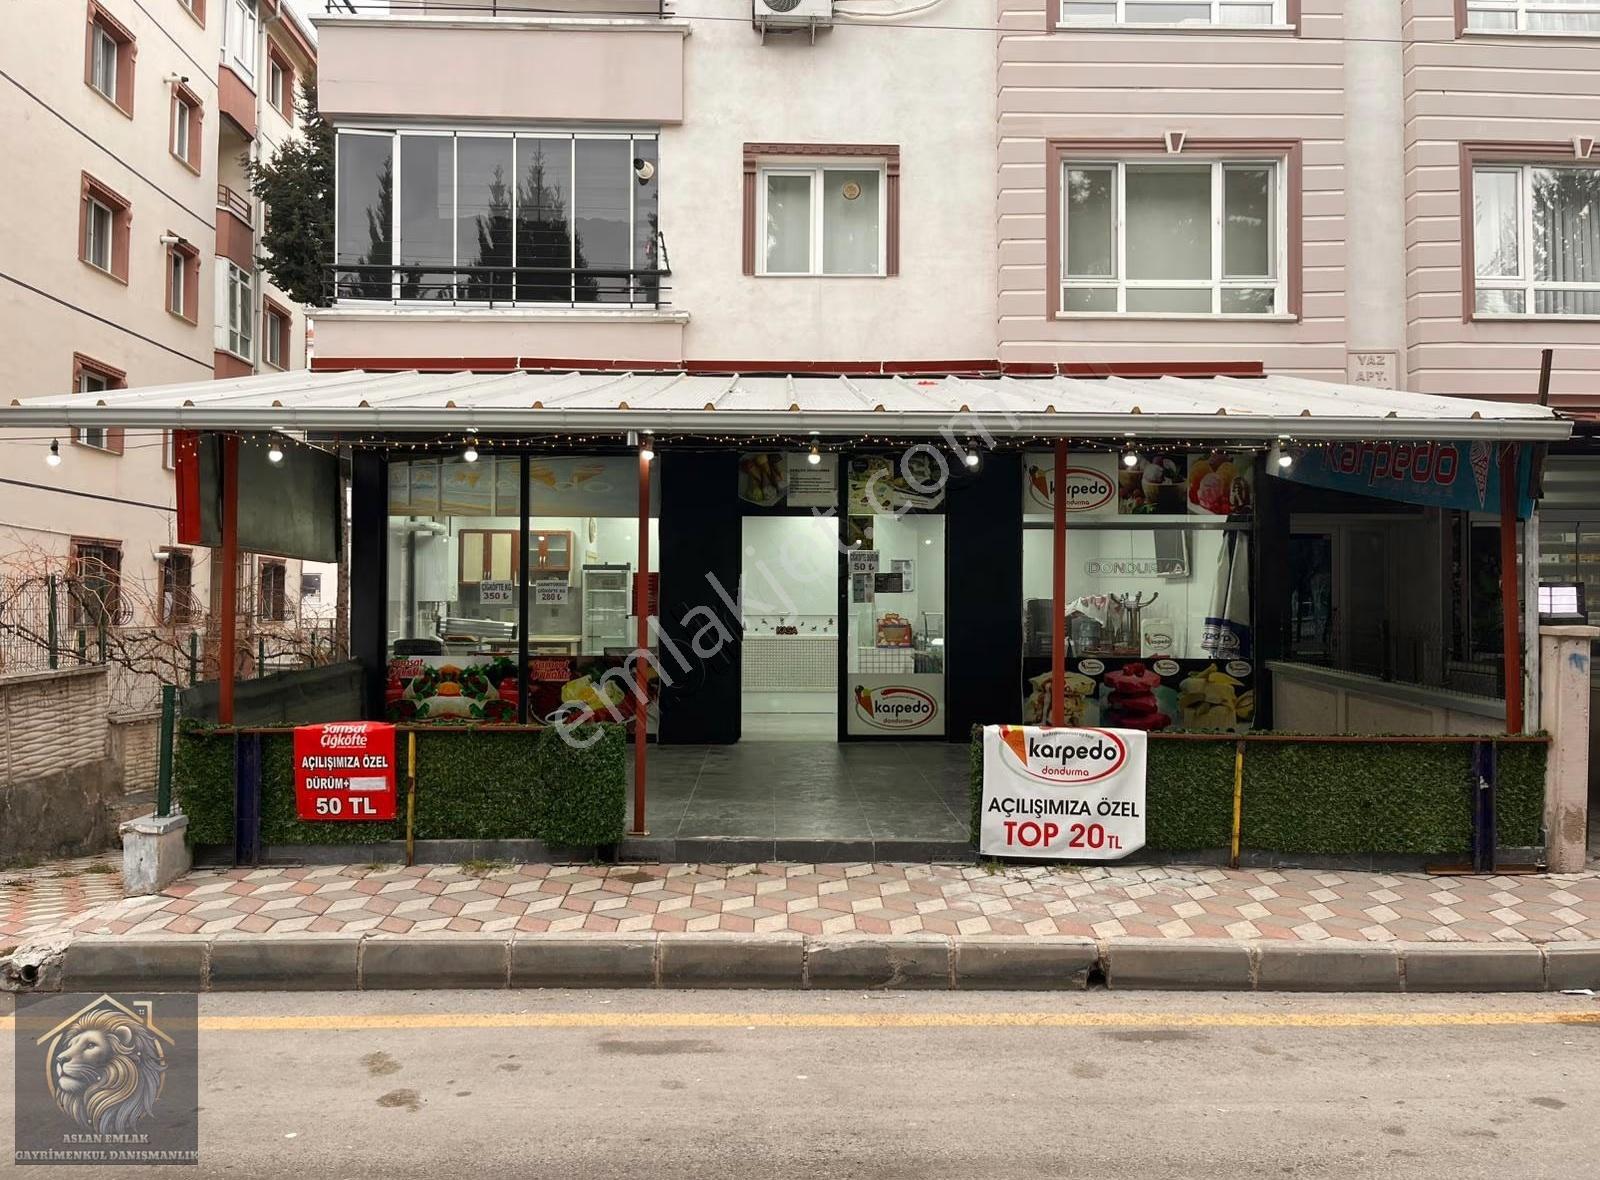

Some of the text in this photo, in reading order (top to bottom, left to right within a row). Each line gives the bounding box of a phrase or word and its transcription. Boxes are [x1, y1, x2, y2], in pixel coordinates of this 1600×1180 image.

[1355, 370, 1387, 382] APT.
[1050, 481, 1107, 499] krpedo
[776, 626, 798, 635] KASA
[875, 700, 930, 717] karpedo
[322, 724, 367, 734] Samsat
[320, 734, 368, 749] Çiğköfte
[1029, 737, 1117, 765] karpedo
[302, 754, 389, 771] AÇILIŞIMIZA ÖZEL
[1041, 766, 1089, 777] dondurma
[316, 797, 377, 815] 50 TL
[988, 797, 1140, 818] AÇILIŞIMIZA ÖZEL
[1004, 821, 1122, 849] TOP 20 TL
